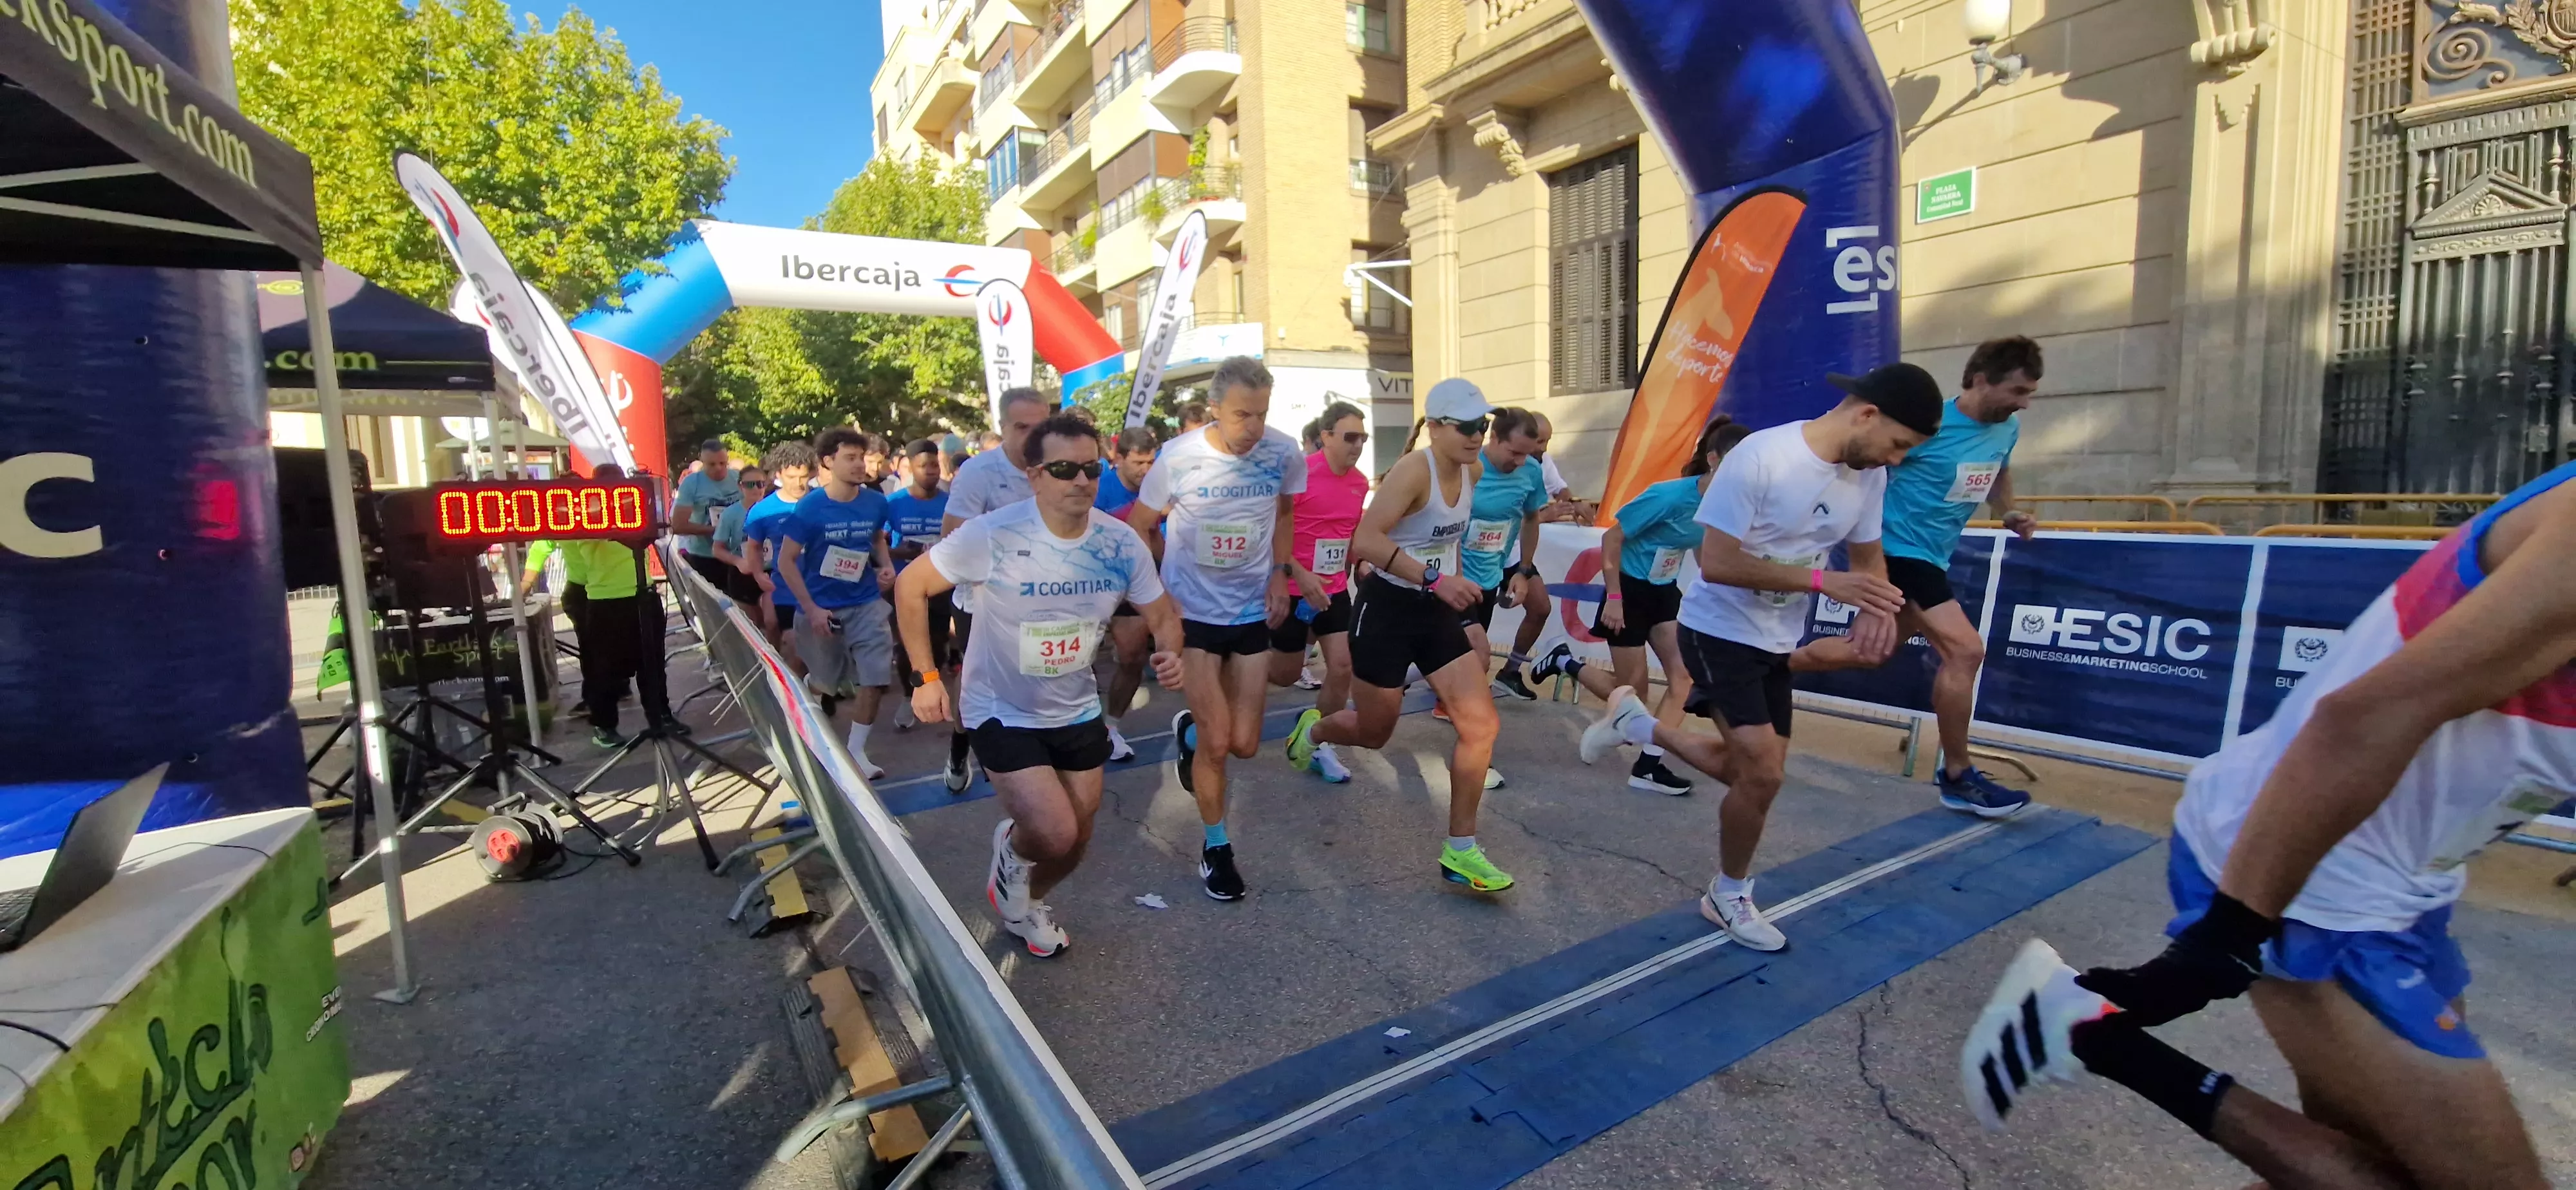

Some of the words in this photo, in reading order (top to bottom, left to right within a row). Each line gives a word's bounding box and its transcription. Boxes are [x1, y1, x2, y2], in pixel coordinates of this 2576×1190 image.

[1936, 184, 1956, 194] PLAZA
[781, 254, 922, 292] Ibercaja
[1130, 293, 1178, 419] Ibercaja
[1965, 473, 1992, 486] 565
[1211, 485, 1274, 498] COGITIAR
[440, 486, 643, 535] 00:00:00
[1477, 531, 1502, 541] 564
[1211, 536, 1246, 551] 312
[1326, 548, 1344, 560] 131
[834, 557, 860, 571] 394
[1038, 579, 1112, 596] COGITIAR
[2058, 608, 2211, 661] ESIC
[1040, 636, 1081, 657] 314
[1045, 655, 1076, 666] PEDRO
